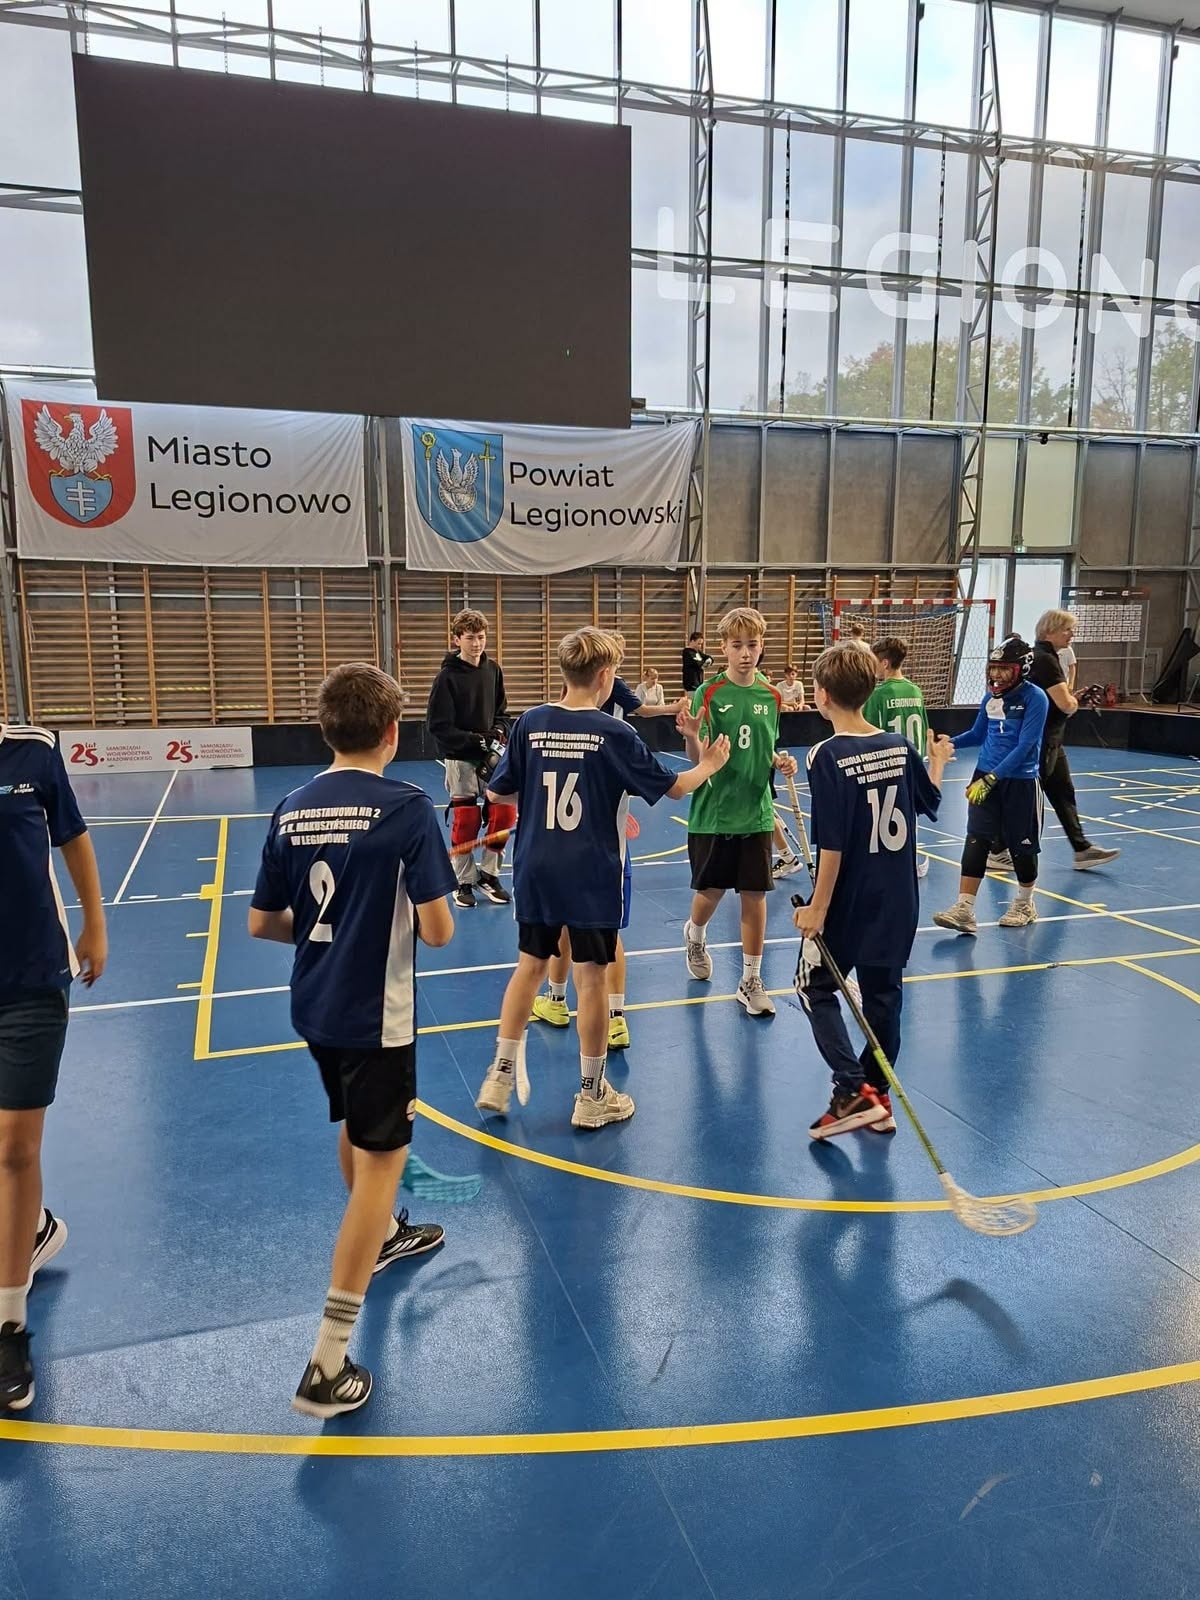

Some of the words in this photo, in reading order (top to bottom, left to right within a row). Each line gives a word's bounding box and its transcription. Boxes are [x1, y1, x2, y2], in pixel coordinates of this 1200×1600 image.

[147, 435, 272, 469] Miasto
[510, 461, 614, 488] Powiat
[150, 482, 352, 519] Legionowo
[510, 499, 683, 532] Legionowski
[753, 704, 762, 715] SP
[600, 736, 605, 744] 2
[738, 724, 751, 749] 8
[887, 713, 922, 755] 10
[856, 775, 866, 785] W
[299, 806, 358, 819] PODSTAWOWA
[358, 807, 372, 817] NR
[372, 808, 381, 818] 2
[542, 771, 583, 832] 16
[295, 819, 370, 833] MAKUSZYŃSKIEGO
[866, 784, 908, 853] 16
[290, 835, 300, 846] W
[308, 860, 336, 943] 2
